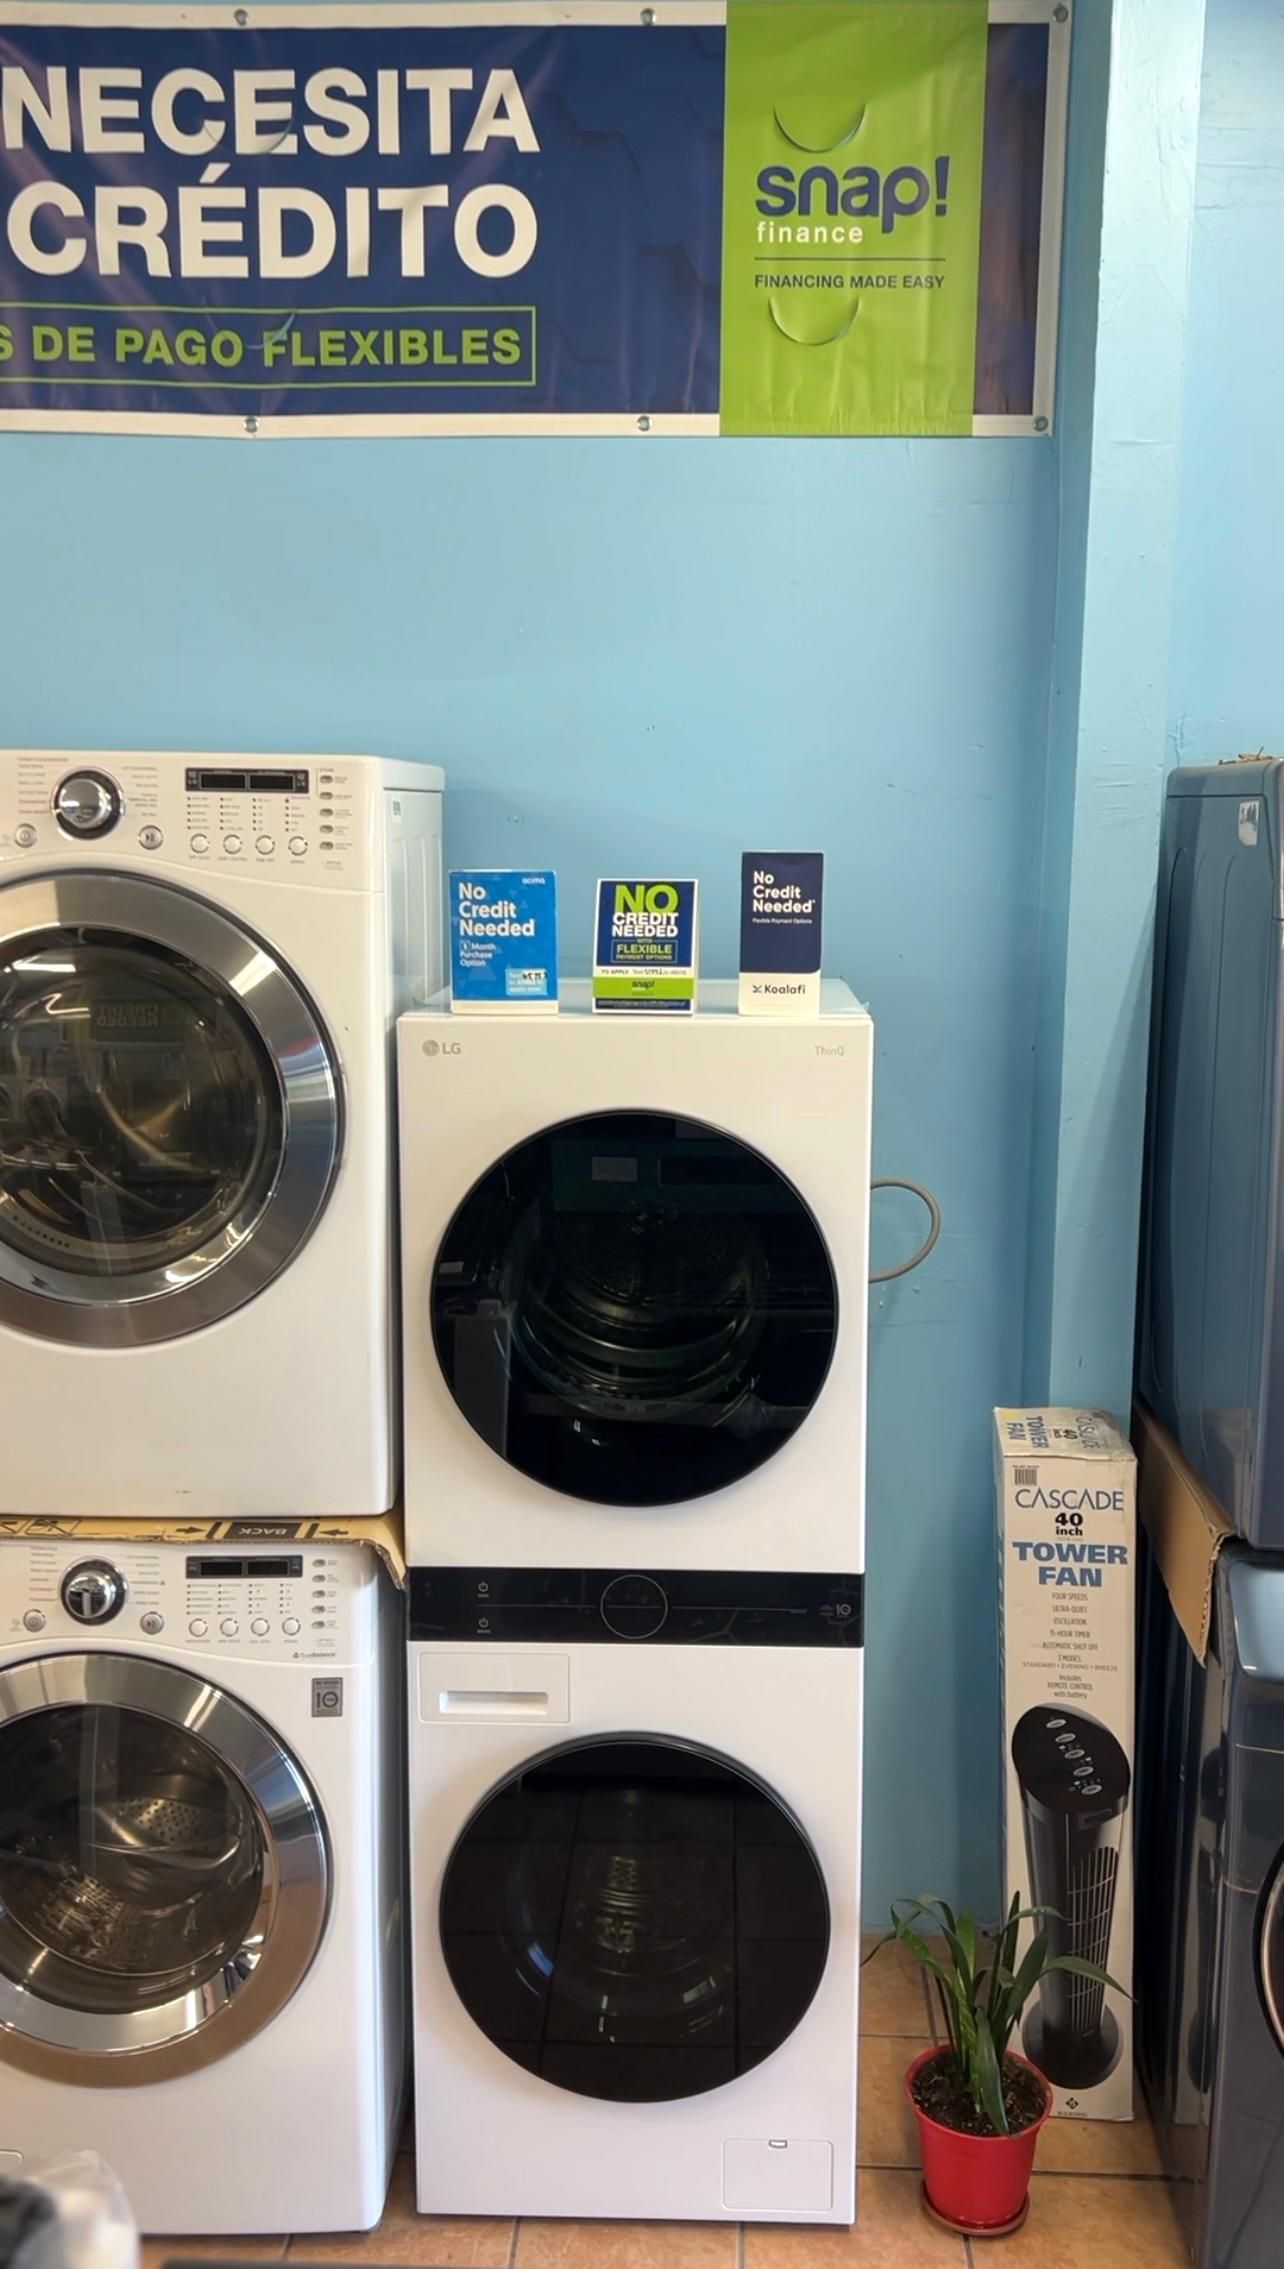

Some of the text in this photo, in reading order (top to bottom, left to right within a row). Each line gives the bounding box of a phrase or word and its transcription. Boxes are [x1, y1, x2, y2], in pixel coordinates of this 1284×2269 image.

[2, 65, 541, 156] NECESITA
[755, 155, 950, 235] snap!
[7, 163, 538, 278] CRÉDITO
[756, 220, 863, 244] finance
[754, 273, 946, 290] FINANCING MADE EASY
[32, 325, 96, 362] DE
[115, 328, 244, 368] PAGO
[262, 327, 522, 368] FLEXIBLES
[753, 870, 774, 885] No
[458, 882, 486, 900] No
[753, 885, 801, 899] Credit
[615, 884, 679, 914] NO
[459, 900, 517, 918] Credit
[613, 912, 679, 926] CREDIT
[459, 918, 535, 937] Needed
[612, 925, 679, 938] NEEDED
[471, 942, 496, 950] Month
[616, 944, 673, 954] FLEXIBLE
[460, 951, 493, 959] Purchase
[460, 959, 486, 967] Option
[764, 984, 806, 994] Koalafi
[442, 1043, 461, 1056] LG
[814, 1045, 845, 1057] ThinQ
[1014, 1487, 1125, 1511] CASCADE
[1054, 1512, 1084, 1526] 40
[237, 1526, 288, 1536] BACK
[1055, 1526, 1084, 1537] inch
[1012, 1541, 1128, 1565] TOWER
[1038, 1566, 1103, 1587] FAN
